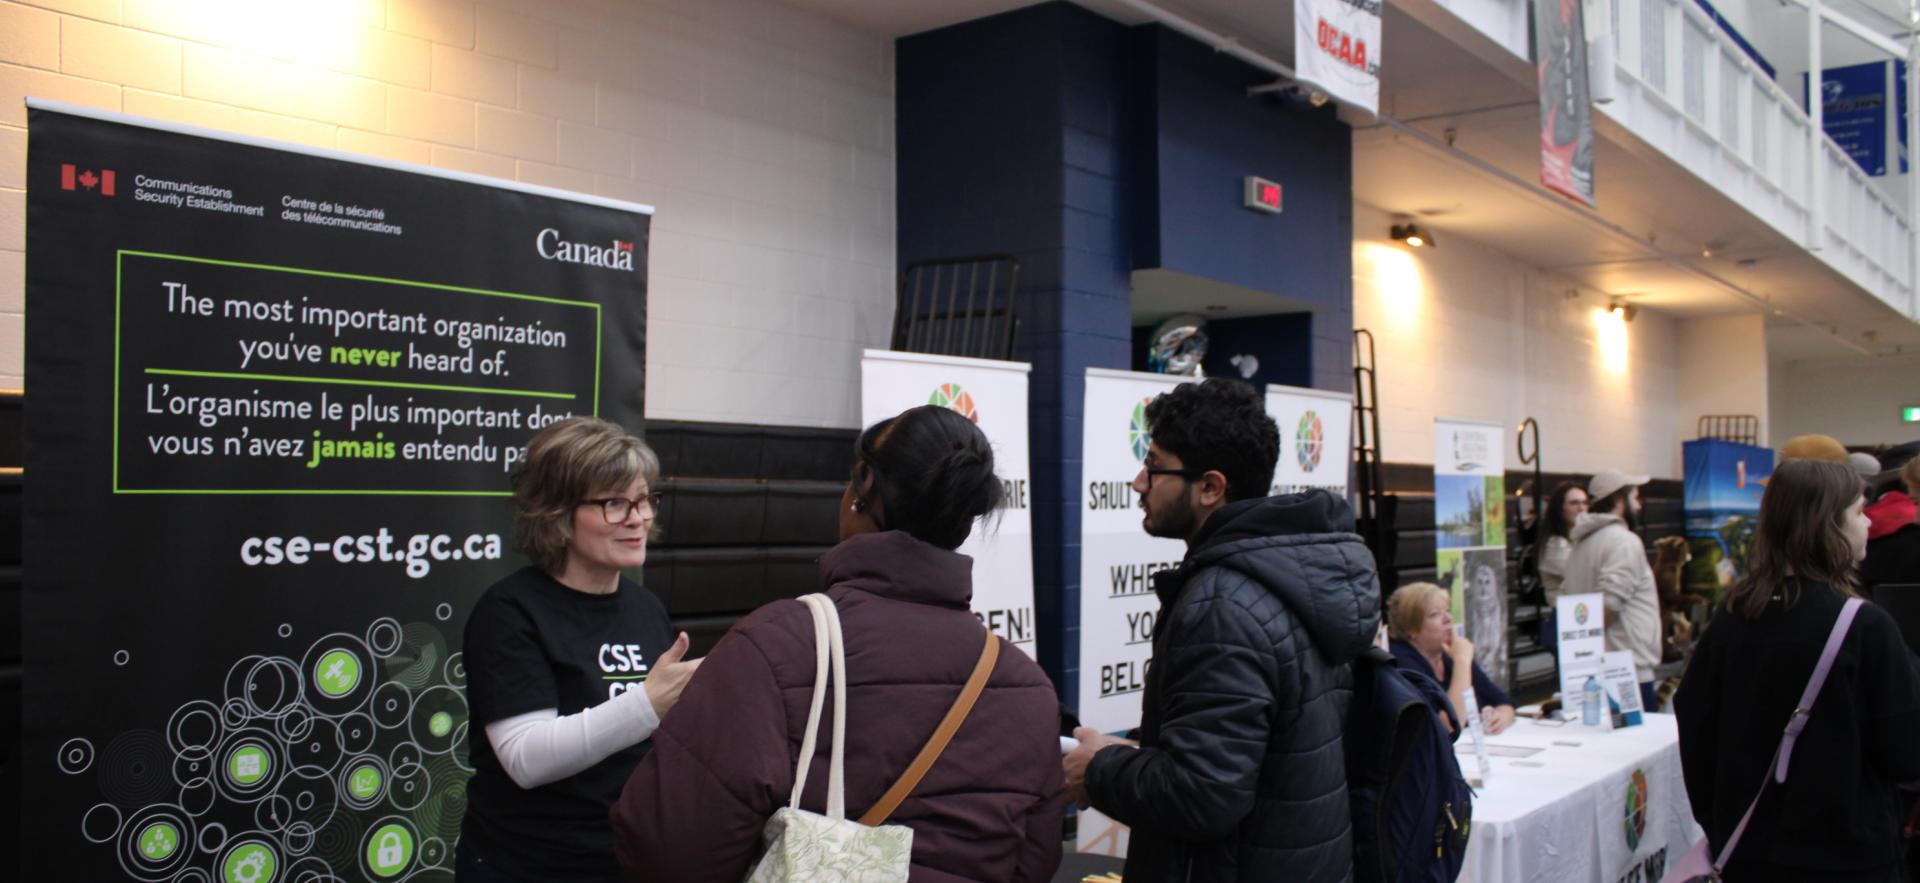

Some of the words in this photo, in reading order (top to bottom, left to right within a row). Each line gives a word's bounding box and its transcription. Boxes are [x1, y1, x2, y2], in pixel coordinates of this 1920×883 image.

[134, 174, 233, 200] Communications
[134, 188, 184, 208] Security
[186, 195, 264, 217] Establishment
[281, 195, 317, 212] Centre
[318, 199, 333, 213] de
[334, 202, 344, 215] la
[345, 204, 385, 220] sécurité
[281, 209, 301, 222] des
[302, 212, 402, 235] télécommunications
[536, 228, 634, 271] Canada
[161, 282, 214, 316] The
[224, 298, 294, 323] most
[301, 296, 427, 337] important
[433, 317, 567, 348] organization
[239, 332, 322, 369] you've
[329, 346, 402, 368] never
[408, 342, 473, 373] heard
[479, 350, 509, 377] of.
[146, 383, 312, 427] L’organisme
[321, 392, 343, 420] le
[351, 394, 400, 432] plus
[407, 397, 521, 435] important
[148, 435, 214, 455] vous
[224, 427, 304, 457] n’avez
[306, 430, 396, 468] jamais
[402, 435, 497, 462] entendu
[504, 445, 528, 473] pa
[1001, 479, 1026, 509] RIE
[1089, 481, 1132, 510] SAULT
[240, 527, 501, 579] cse-cst.gc.ca
[1111, 561, 1181, 595] WHE
[976, 607, 1031, 641] EN!
[1127, 610, 1160, 642] YO
[598, 643, 648, 673] CSE
